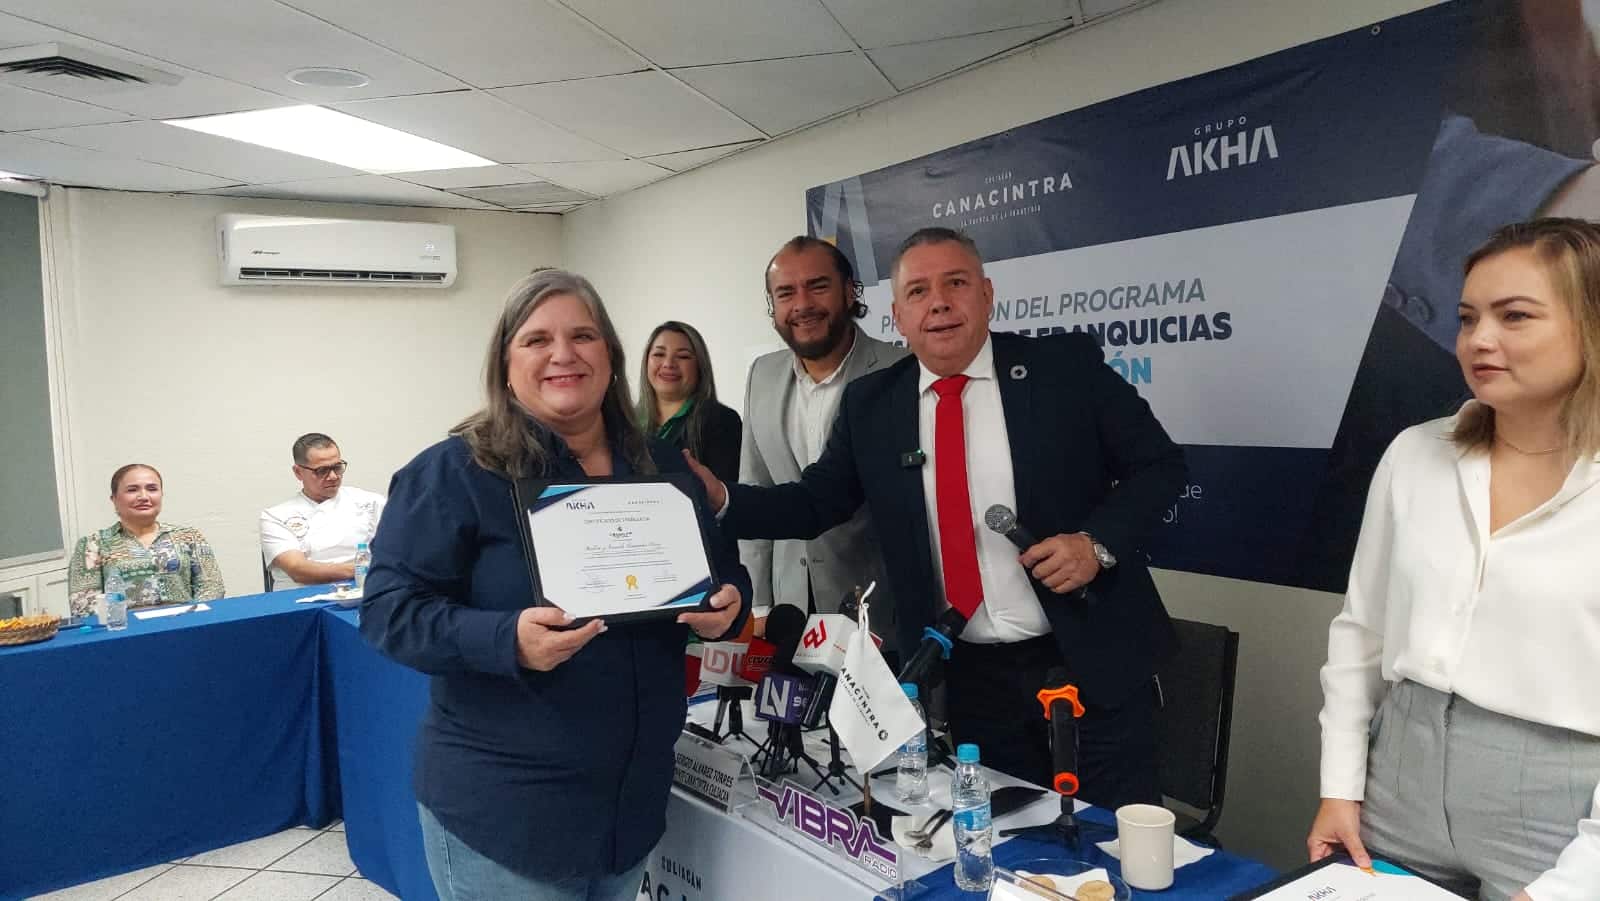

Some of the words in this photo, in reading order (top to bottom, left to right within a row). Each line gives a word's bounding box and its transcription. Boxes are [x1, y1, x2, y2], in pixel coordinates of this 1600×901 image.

[1193, 115, 1247, 136] GRUPO
[1166, 124, 1279, 181] AKHA
[932, 172, 1073, 218] CANACINTRA
[1015, 295, 1053, 319] DEL
[1059, 277, 1206, 316] PROGRAMA
[1036, 312, 1233, 347] NQUICIAS
[840, 667, 880, 729] ANACINTRA
[757, 785, 897, 863] VIBRA
[863, 855, 898, 879] RADIO
